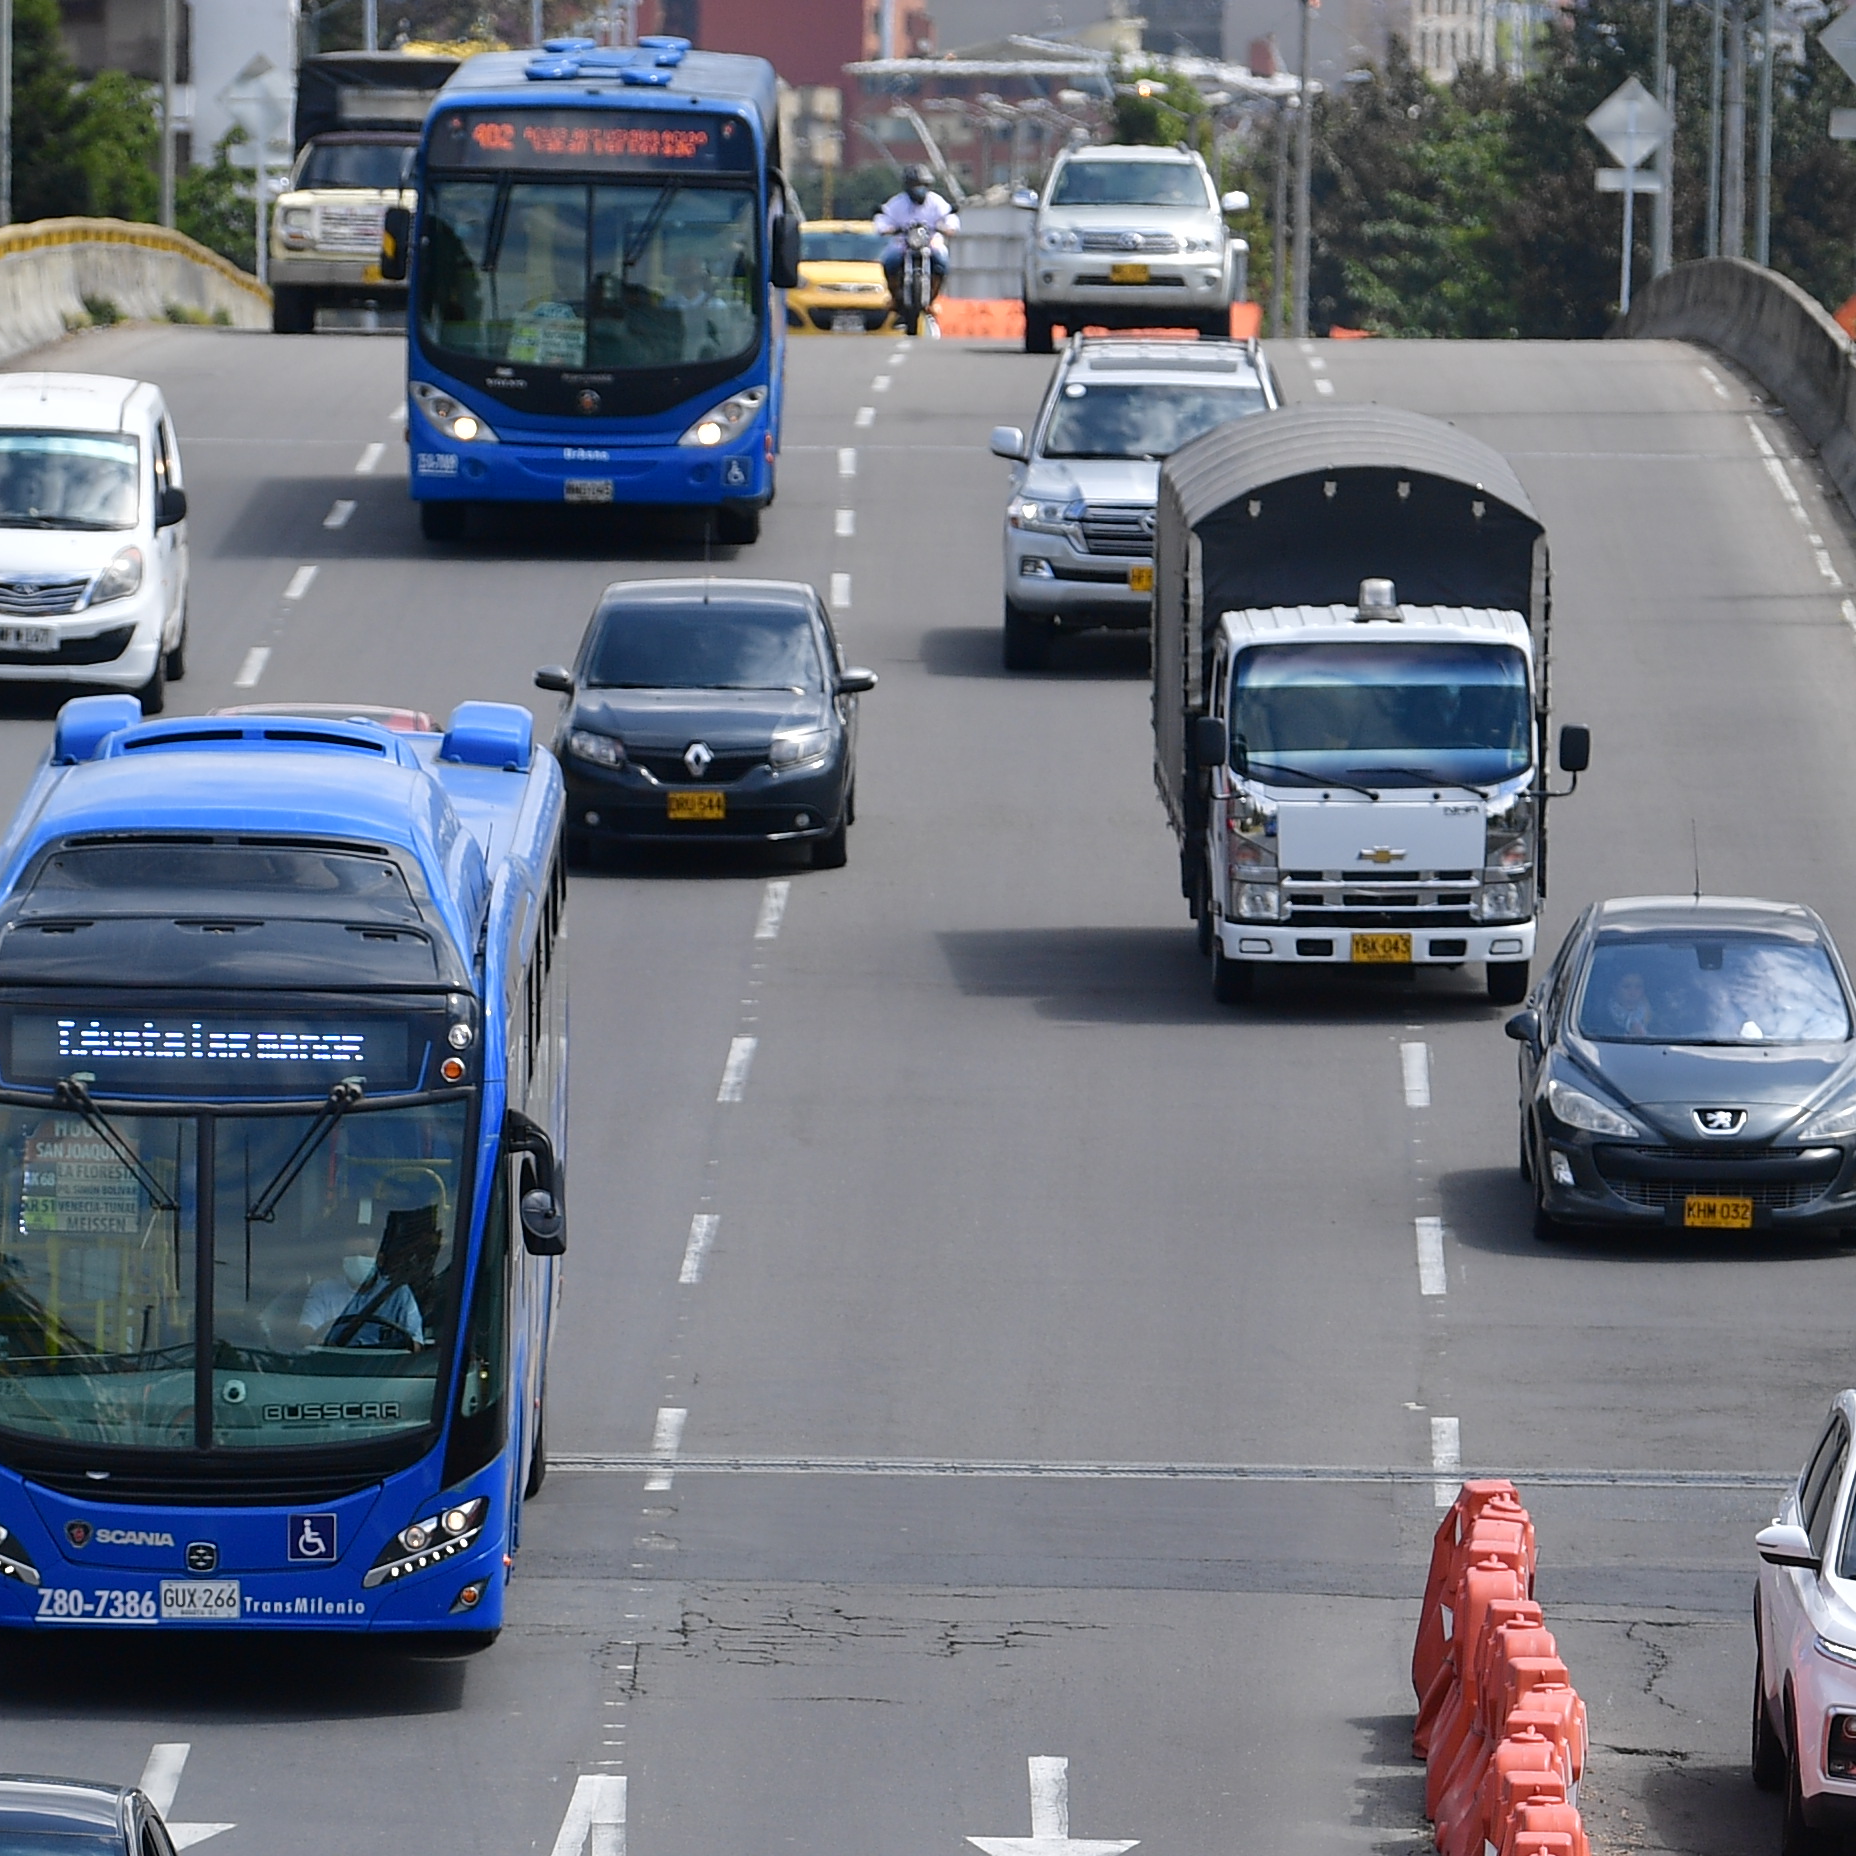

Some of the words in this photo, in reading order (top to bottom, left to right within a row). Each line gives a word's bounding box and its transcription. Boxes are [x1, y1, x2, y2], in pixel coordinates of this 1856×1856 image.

[36, 1142, 63, 1157] SAN
[264, 1402, 401, 1421] BUSSCAR
[96, 1529, 175, 1547] SCANIA
[37, 1588, 156, 1618] Z80-7386
[244, 1596, 365, 1615] TransMilenio
